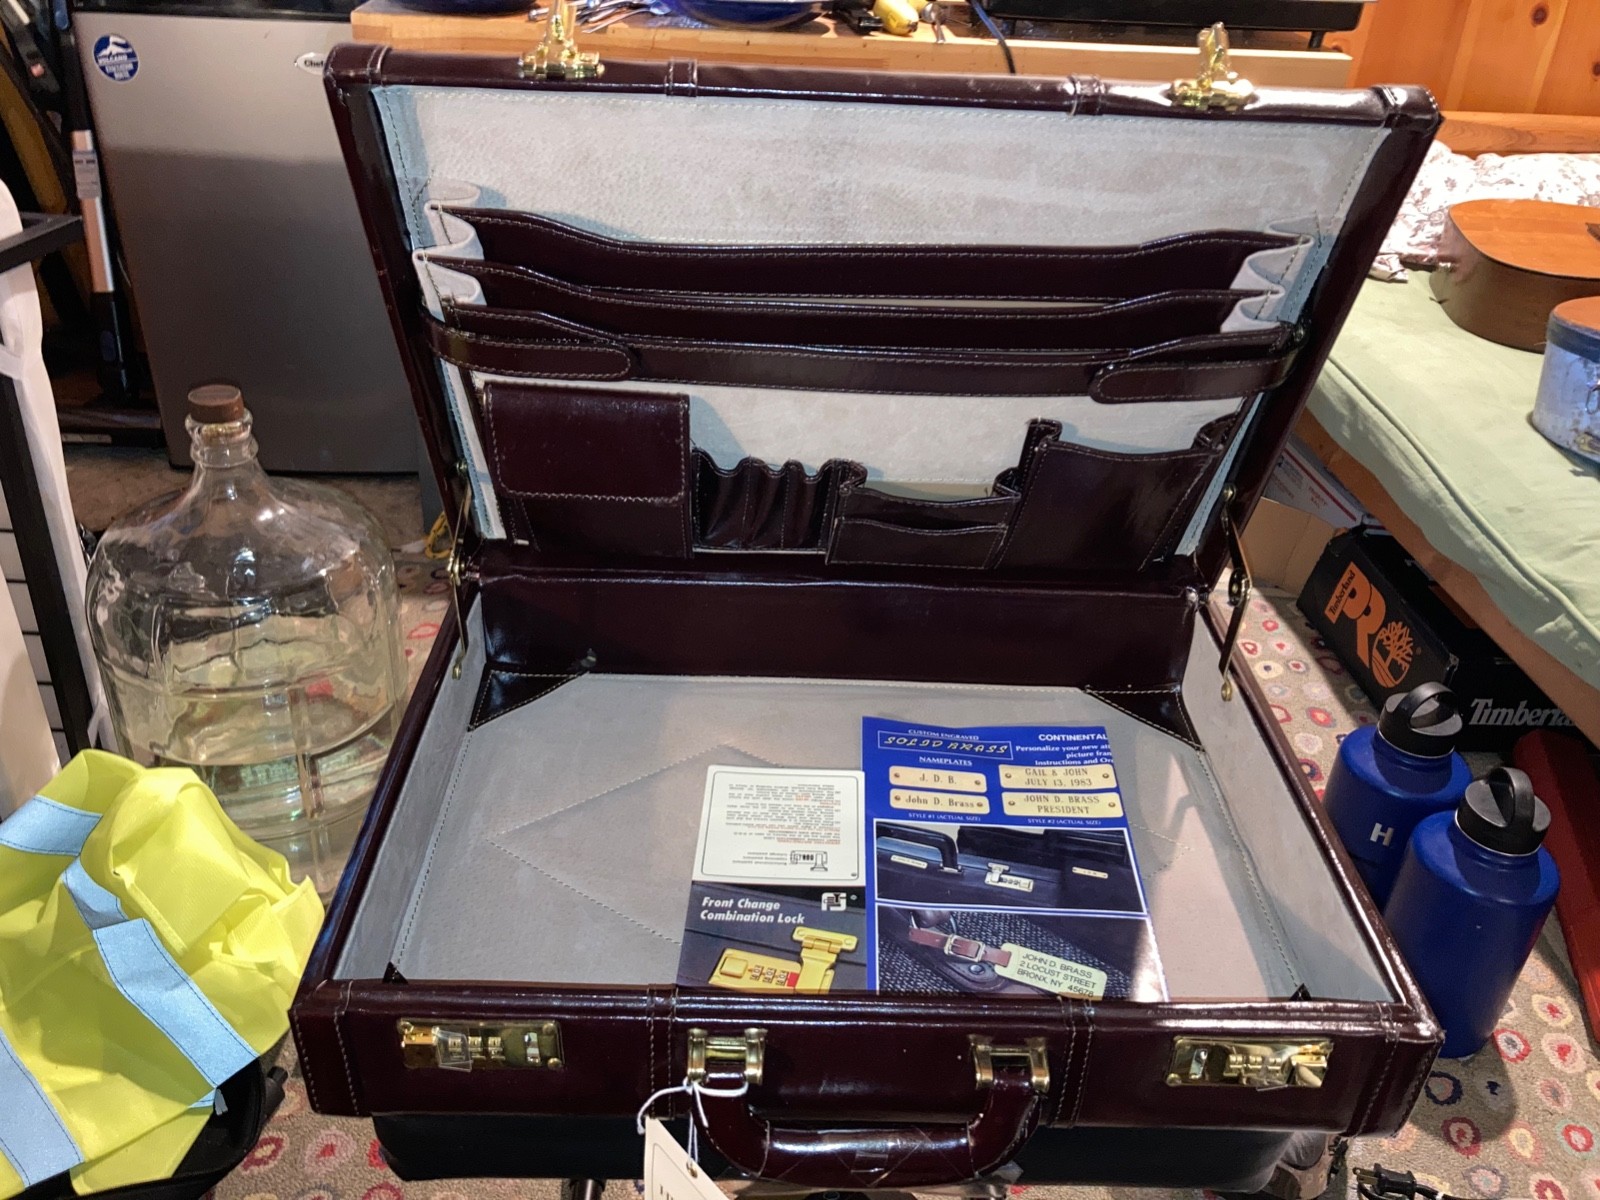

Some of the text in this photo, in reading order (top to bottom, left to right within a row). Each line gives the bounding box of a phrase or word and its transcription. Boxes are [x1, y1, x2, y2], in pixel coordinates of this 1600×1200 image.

[1329, 569, 1356, 616] Timberland
[1468, 698, 1577, 726] Timberla
[948, 742, 1008, 754] BRASS
[919, 756, 972, 766] NAMEPLATES
[919, 773, 957, 784] J. D. B.
[1025, 768, 1088, 776] GAIL & JOHN
[1025, 778, 1048, 786] JULY
[1070, 778, 1092, 786] 1983
[905, 795, 974, 808] John D. Brass
[1024, 795, 1049, 803] JOHN
[1068, 796, 1100, 804] BRASS
[1038, 806, 1090, 814] PRESIDENT
[1370, 822, 1394, 846] H
[702, 896, 781, 912] Front Change
[700, 910, 805, 924] Combination Lock
[1022, 954, 1093, 979] JOHN D. BRASS
[1026, 963, 1060, 977] LOCUST
[1062, 973, 1097, 989] STREET
[1017, 969, 1094, 998] BRONX, NY 45678
